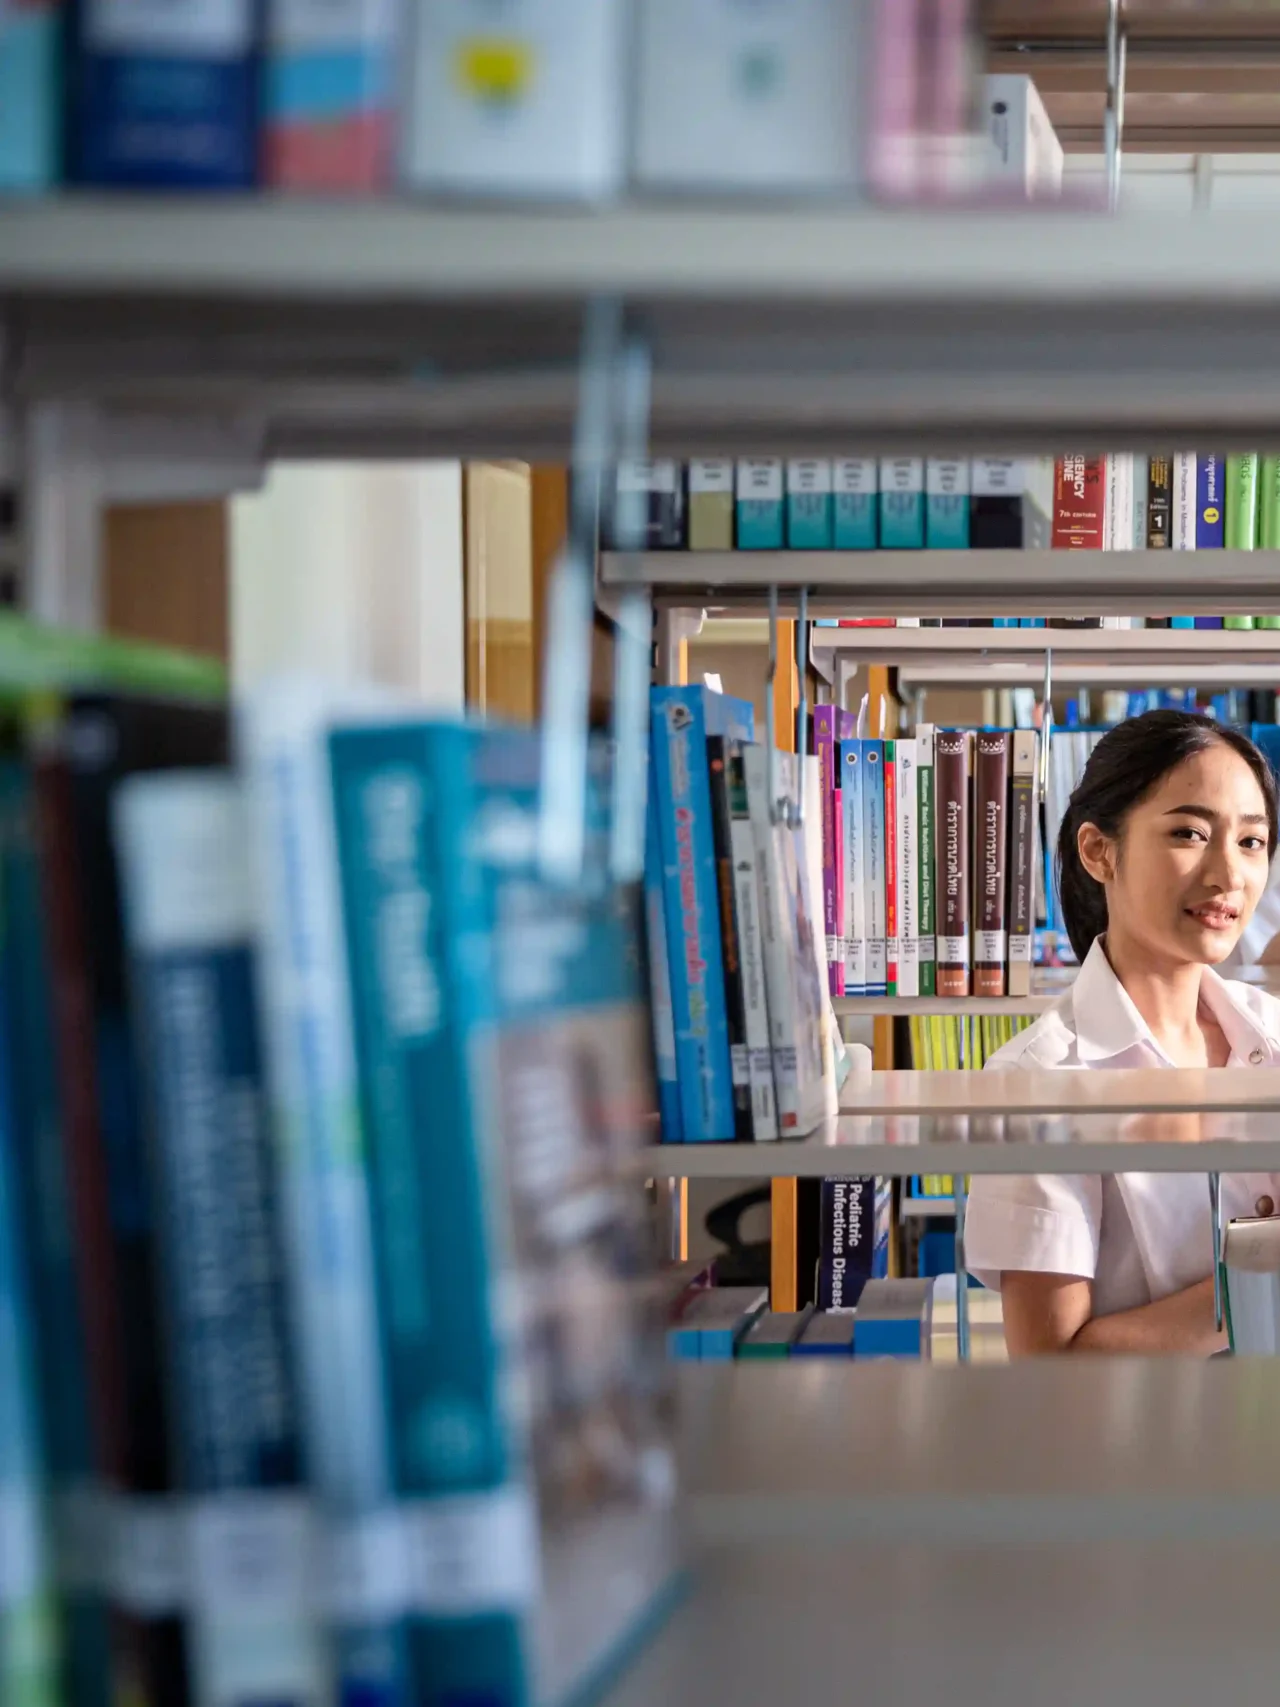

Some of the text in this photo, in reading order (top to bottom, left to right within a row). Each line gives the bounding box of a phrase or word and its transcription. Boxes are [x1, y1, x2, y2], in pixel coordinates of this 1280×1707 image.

[1154, 515, 1163, 528] 1
[921, 806, 930, 826] Basic
[921, 827, 930, 863] Nutrition
[921, 864, 930, 880] and
[921, 881, 930, 898] Diet
[920, 899, 930, 931] Therapy
[832, 1183, 847, 1255] Infectious
[848, 1183, 863, 1247] Pediatric
